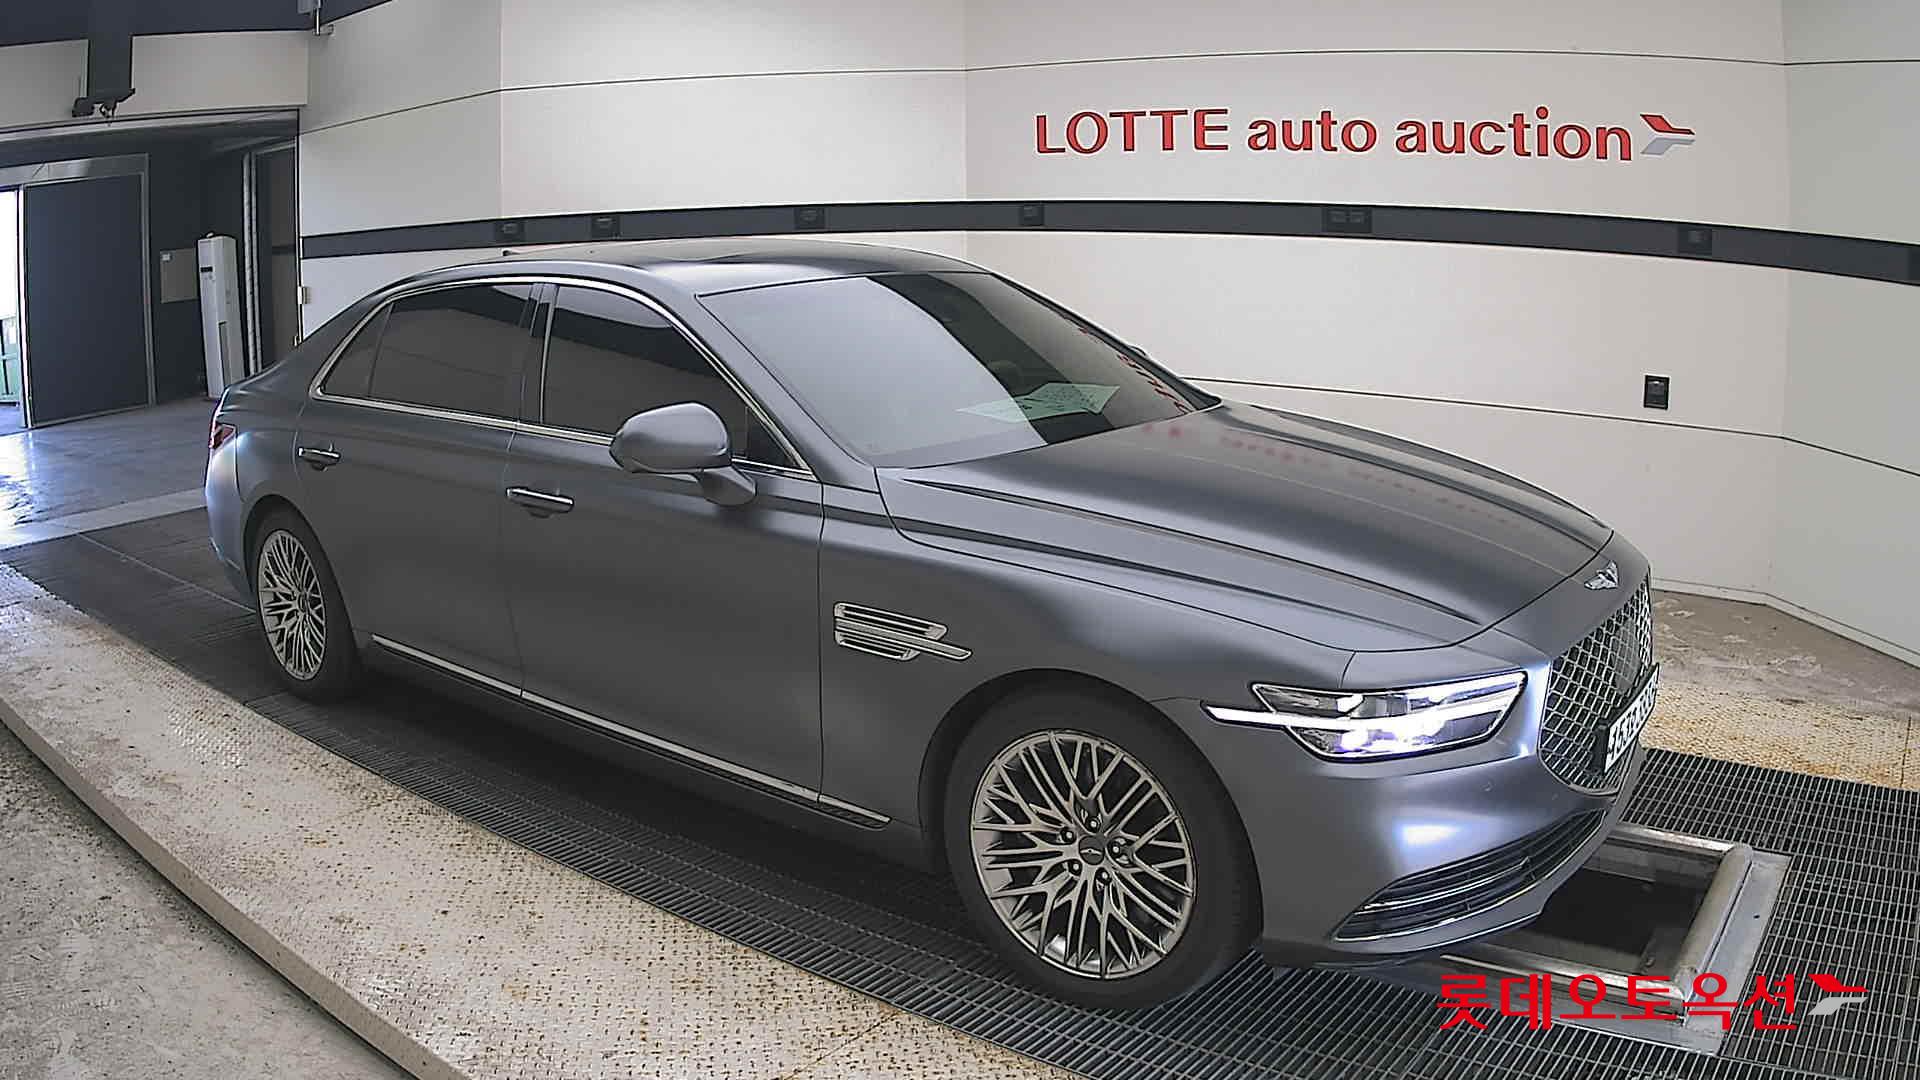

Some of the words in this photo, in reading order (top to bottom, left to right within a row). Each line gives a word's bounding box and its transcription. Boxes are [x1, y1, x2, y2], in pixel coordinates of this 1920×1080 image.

[1035, 108, 1229, 155] LOTTE
[1246, 110, 1378, 153] auto
[1394, 106, 1633, 161] auction
